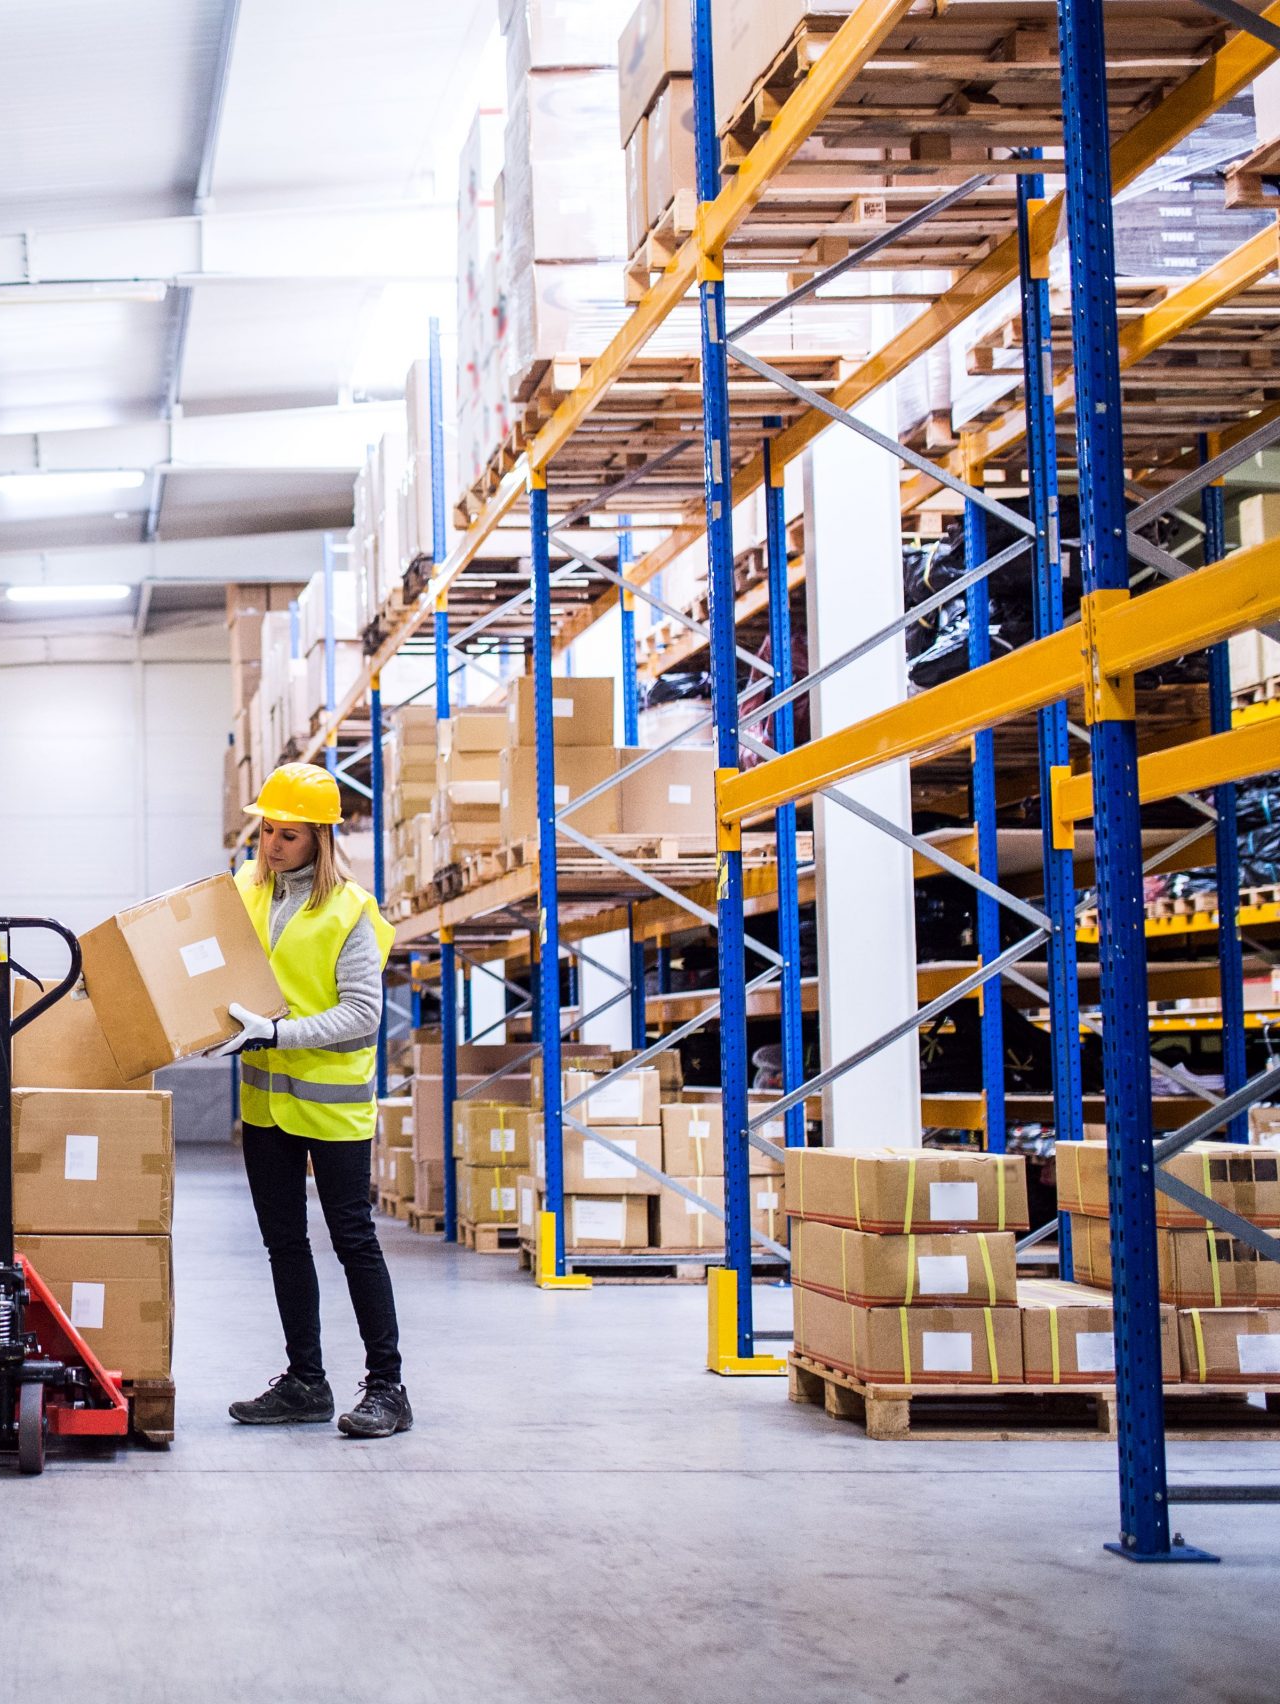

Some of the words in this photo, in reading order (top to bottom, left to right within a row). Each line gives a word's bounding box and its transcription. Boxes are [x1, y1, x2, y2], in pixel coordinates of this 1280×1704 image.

[1159, 207, 1193, 216] THULE
[1161, 232, 1195, 242] THULE
[1164, 257, 1197, 267] THULE
